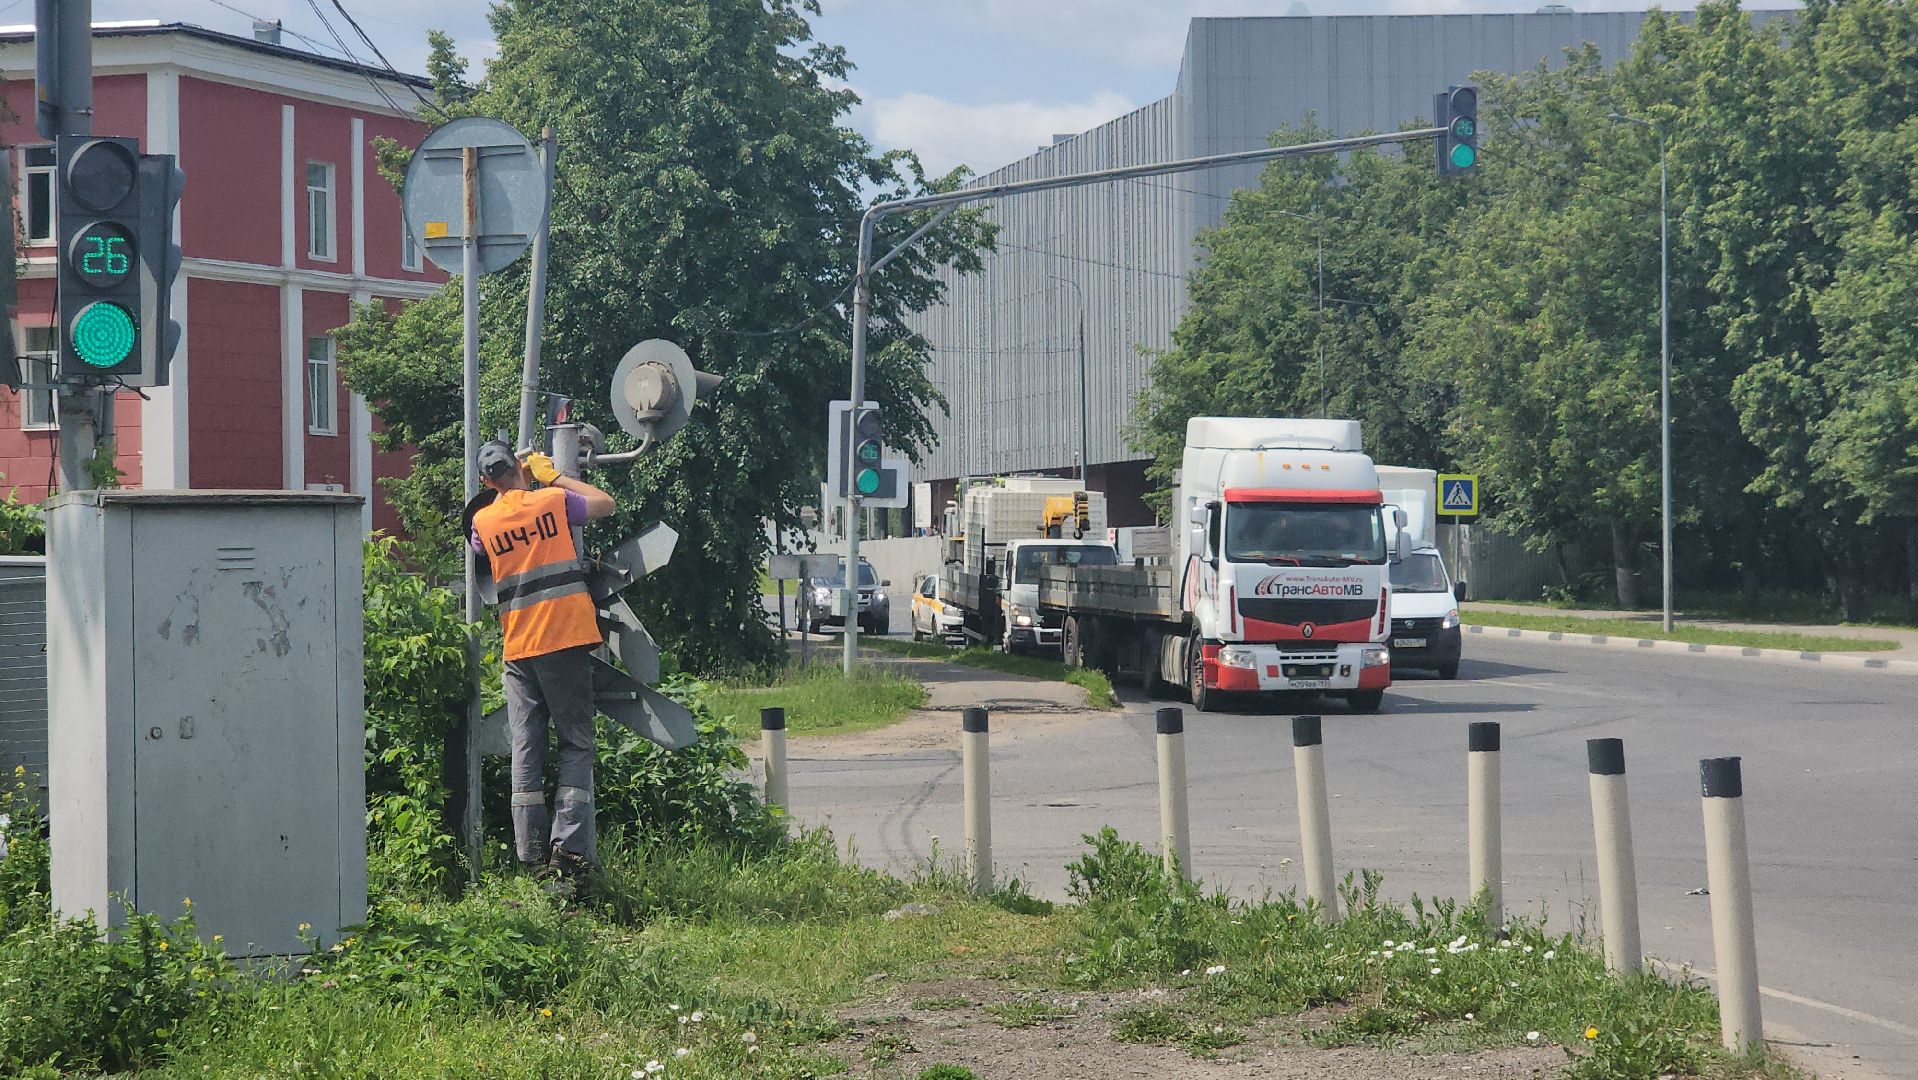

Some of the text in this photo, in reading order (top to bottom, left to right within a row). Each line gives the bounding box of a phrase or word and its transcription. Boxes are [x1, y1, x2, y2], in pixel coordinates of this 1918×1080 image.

[83, 236, 127, 274] 26
[862, 444, 878, 459] 26
[490, 512, 558, 556] ШЧ-10
[1275, 584, 1363, 597] ТрансАвтоМВ
